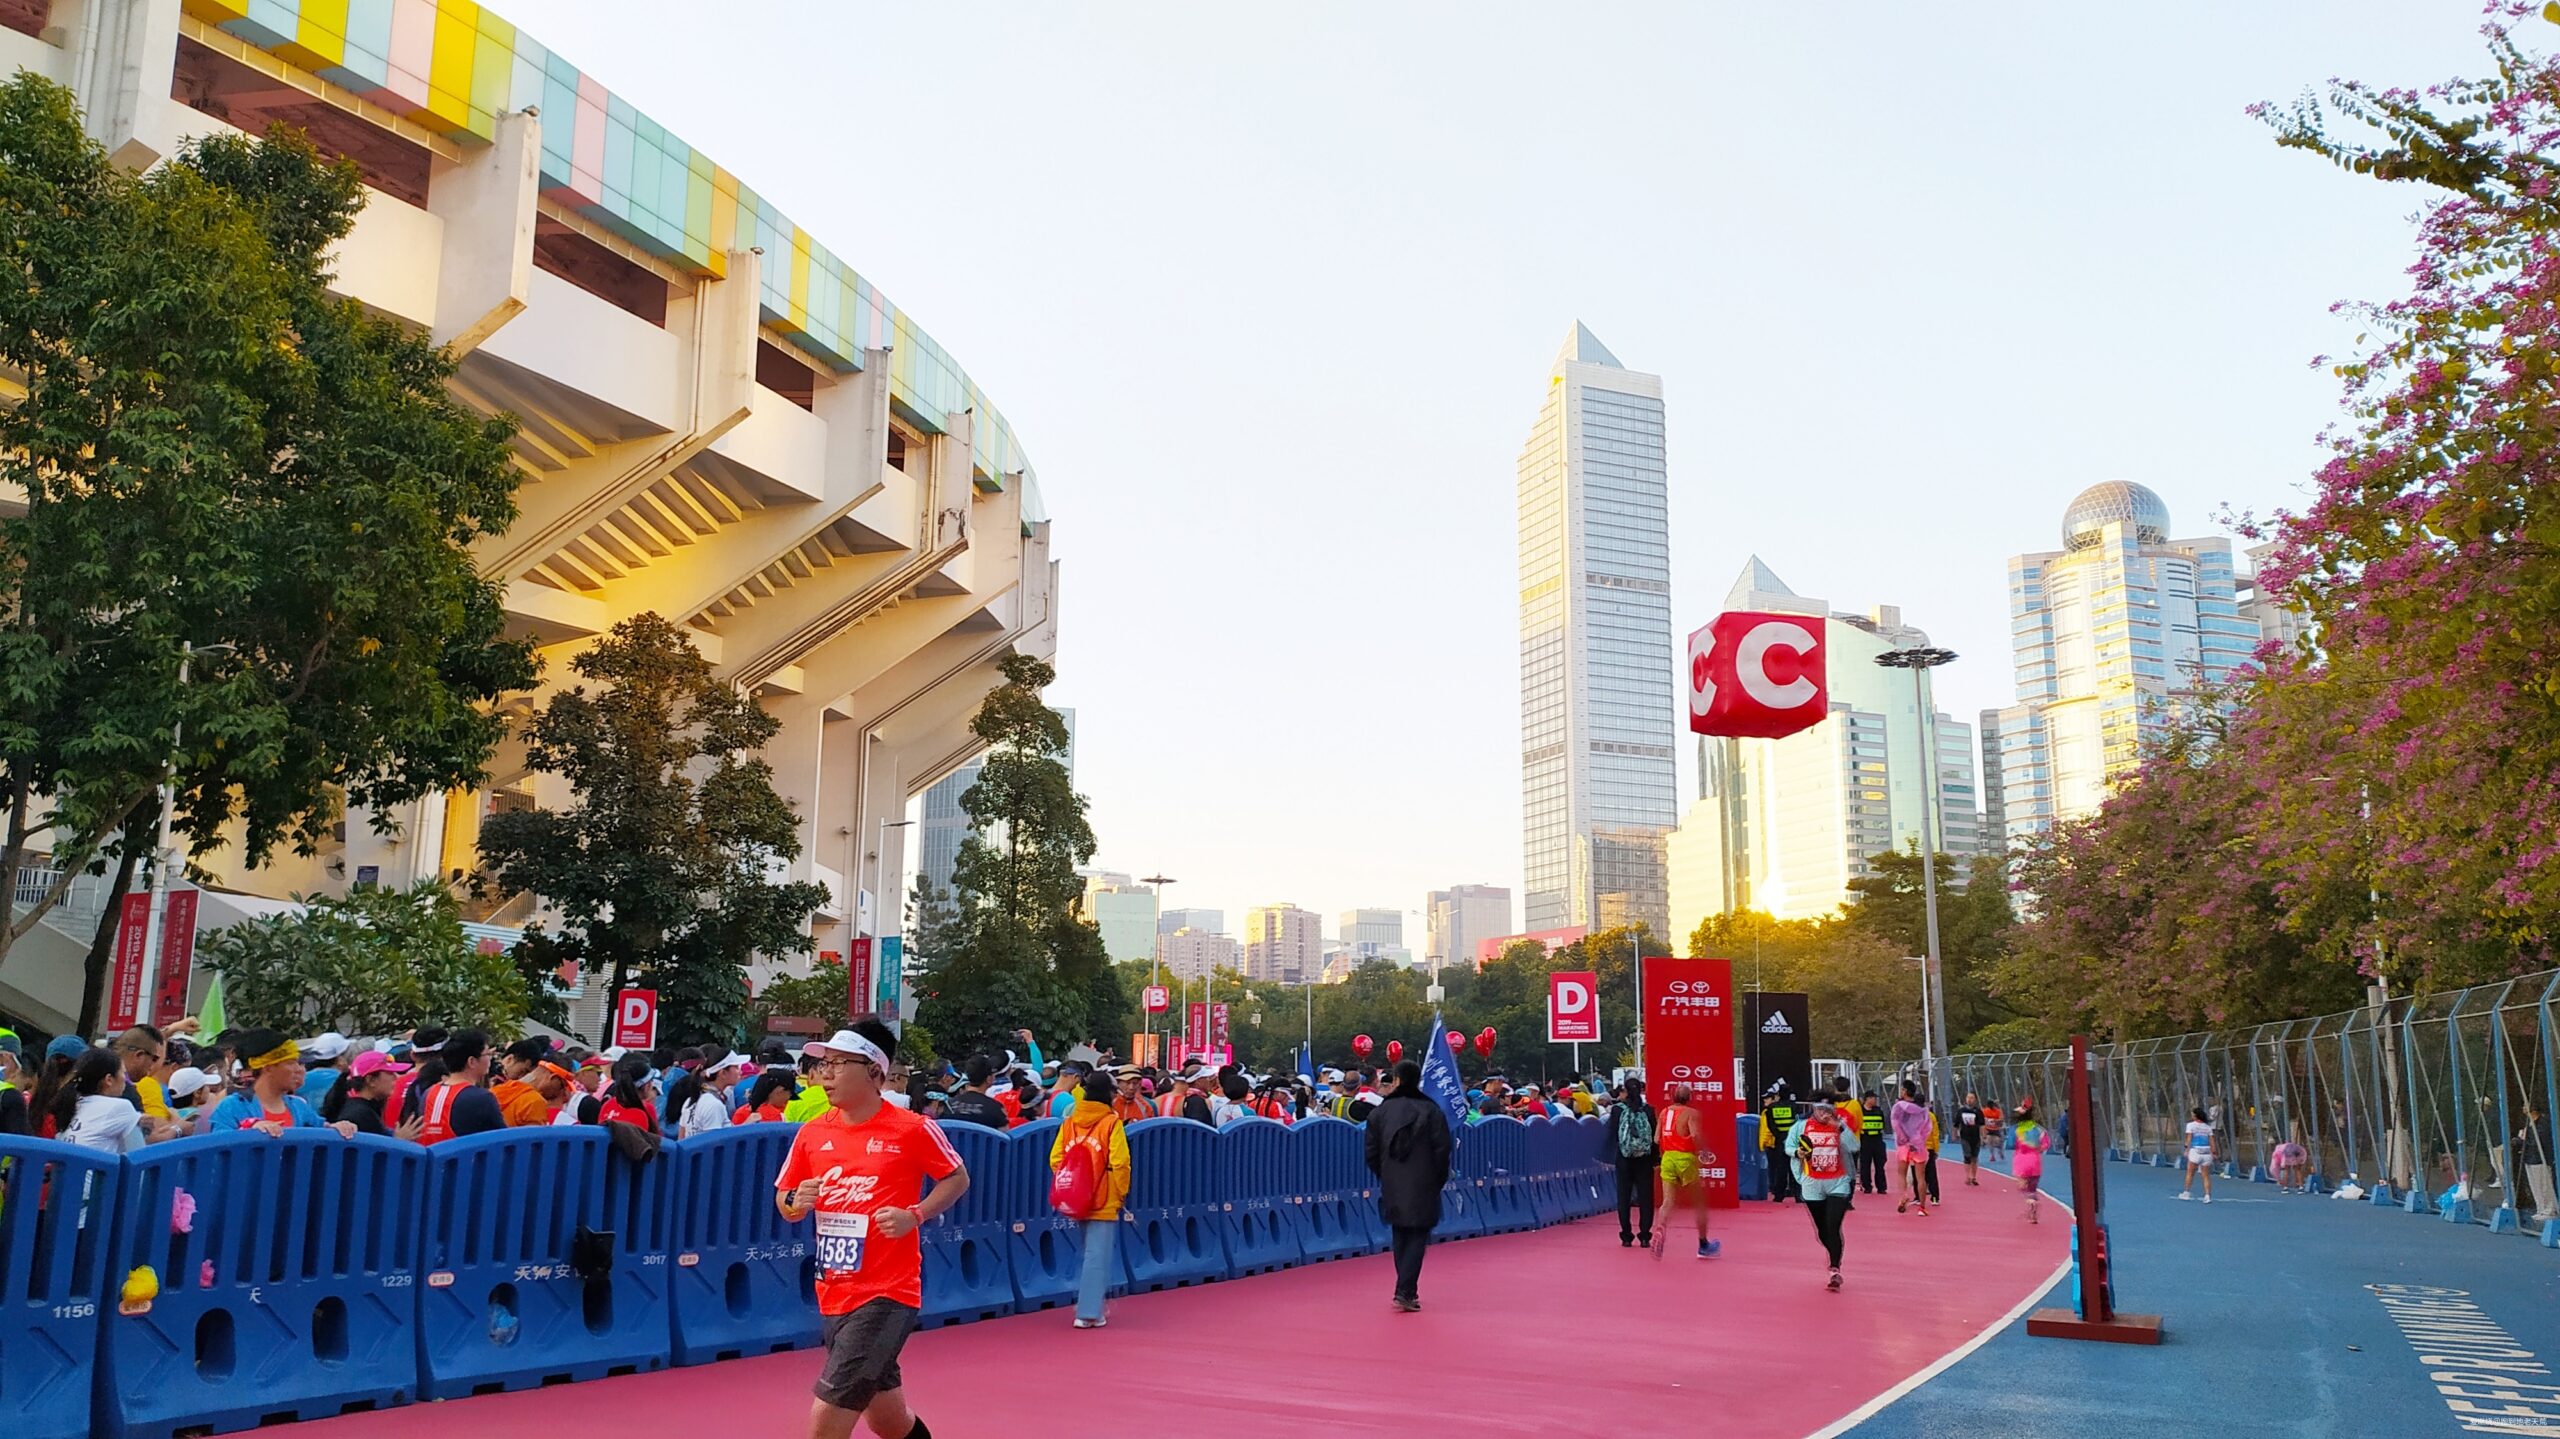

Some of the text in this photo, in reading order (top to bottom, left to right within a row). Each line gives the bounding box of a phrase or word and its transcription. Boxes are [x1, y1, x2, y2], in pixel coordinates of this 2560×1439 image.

[1690, 628, 1717, 716] C
[1736, 621, 1819, 709] C
[1150, 989, 1165, 1006] B
[1557, 982, 1588, 1014] D
[1661, 996, 1719, 1007] 广汽丰田
[623, 998, 649, 1026] D
[1761, 1025, 1793, 1034] adidas
[643, 1255, 667, 1265] 3017
[382, 1275, 412, 1287] 1229
[53, 1304, 95, 1318] 1156
